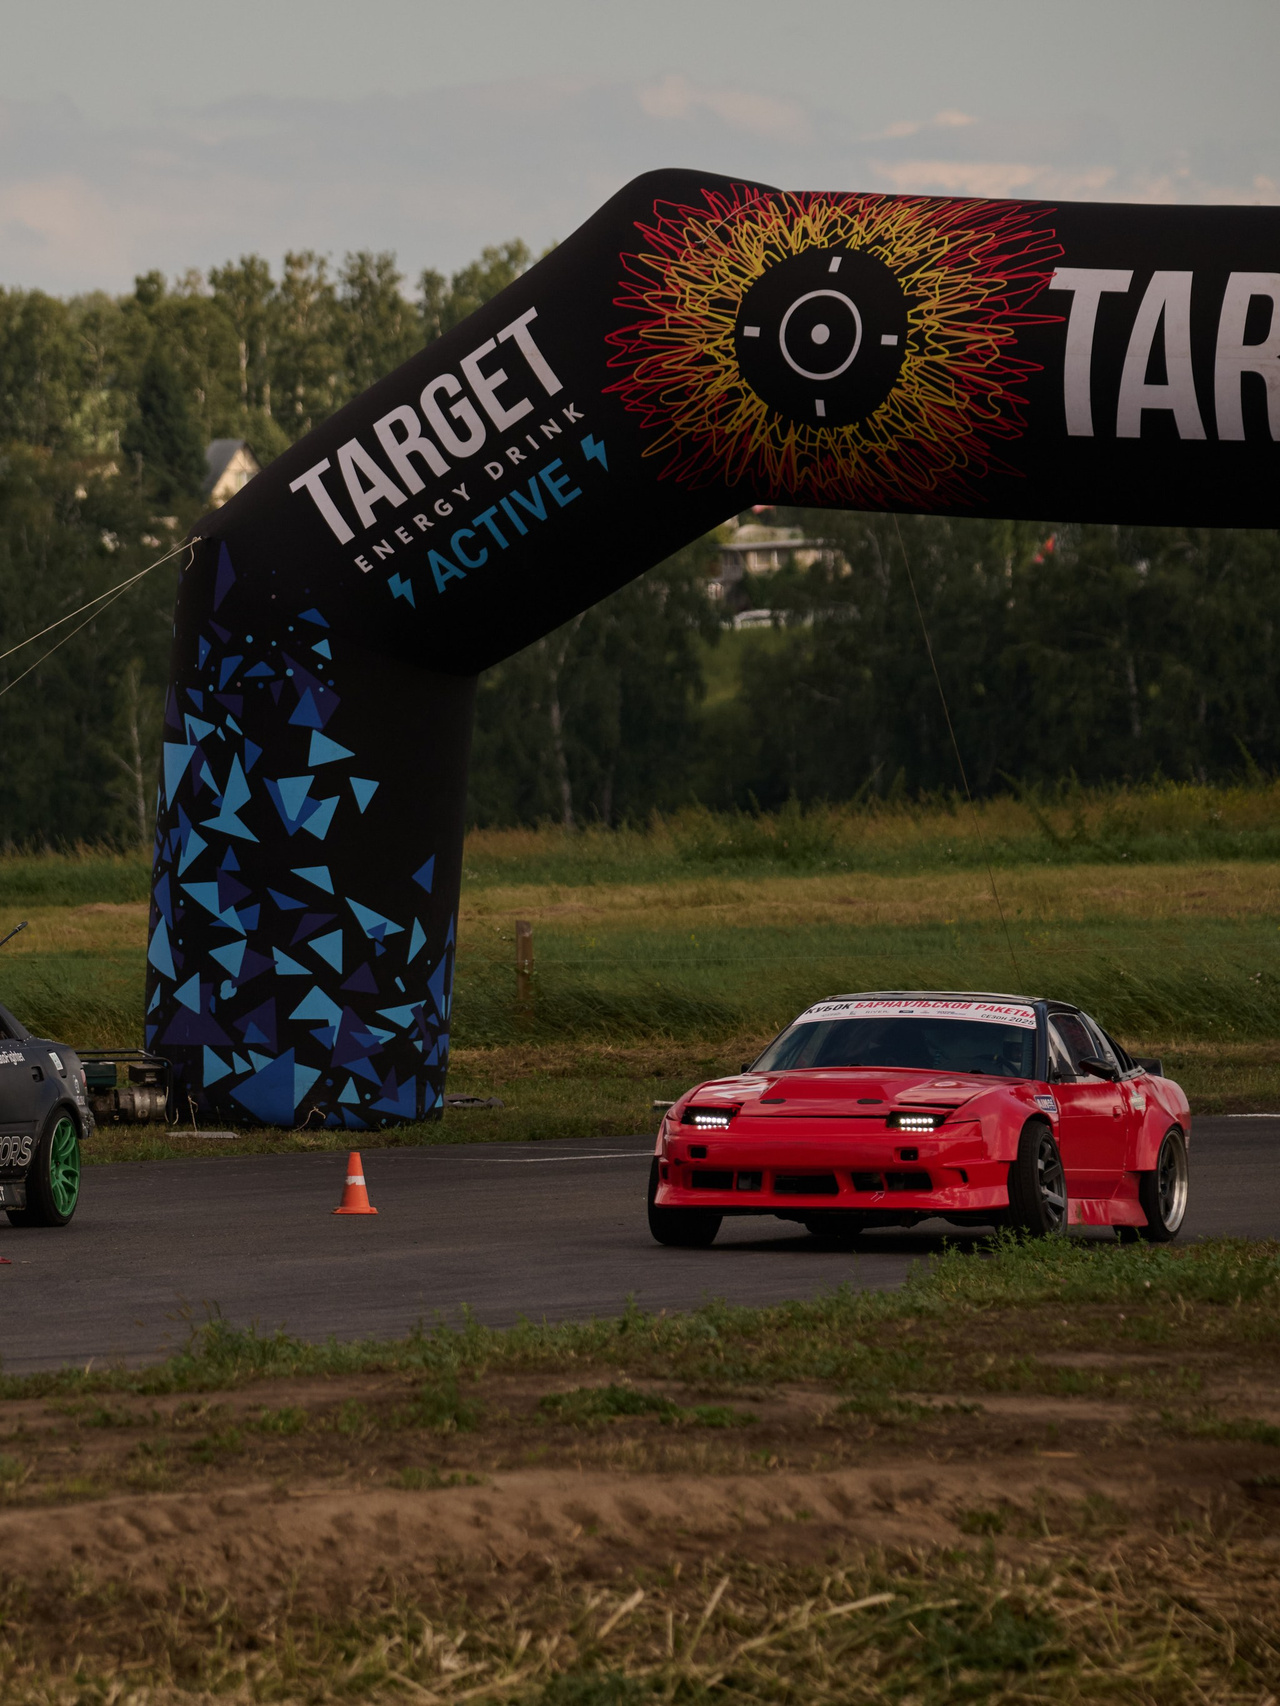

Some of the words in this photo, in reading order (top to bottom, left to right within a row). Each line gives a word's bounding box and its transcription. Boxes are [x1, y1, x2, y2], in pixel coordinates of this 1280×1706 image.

[288, 306, 565, 546] TARGET
[1048, 266, 1280, 443] TAR
[353, 481, 472, 574] ENERGY
[483, 401, 586, 482] DRINK
[427, 458, 584, 596] ACTIVE
[805, 1002, 853, 1016] КУБОК
[854, 1000, 972, 1011] БАРНАУЛЬСКОЙ
[975, 1003, 1036, 1019] РАКЕТЫ
[1008, 1016, 1035, 1026] 2025
